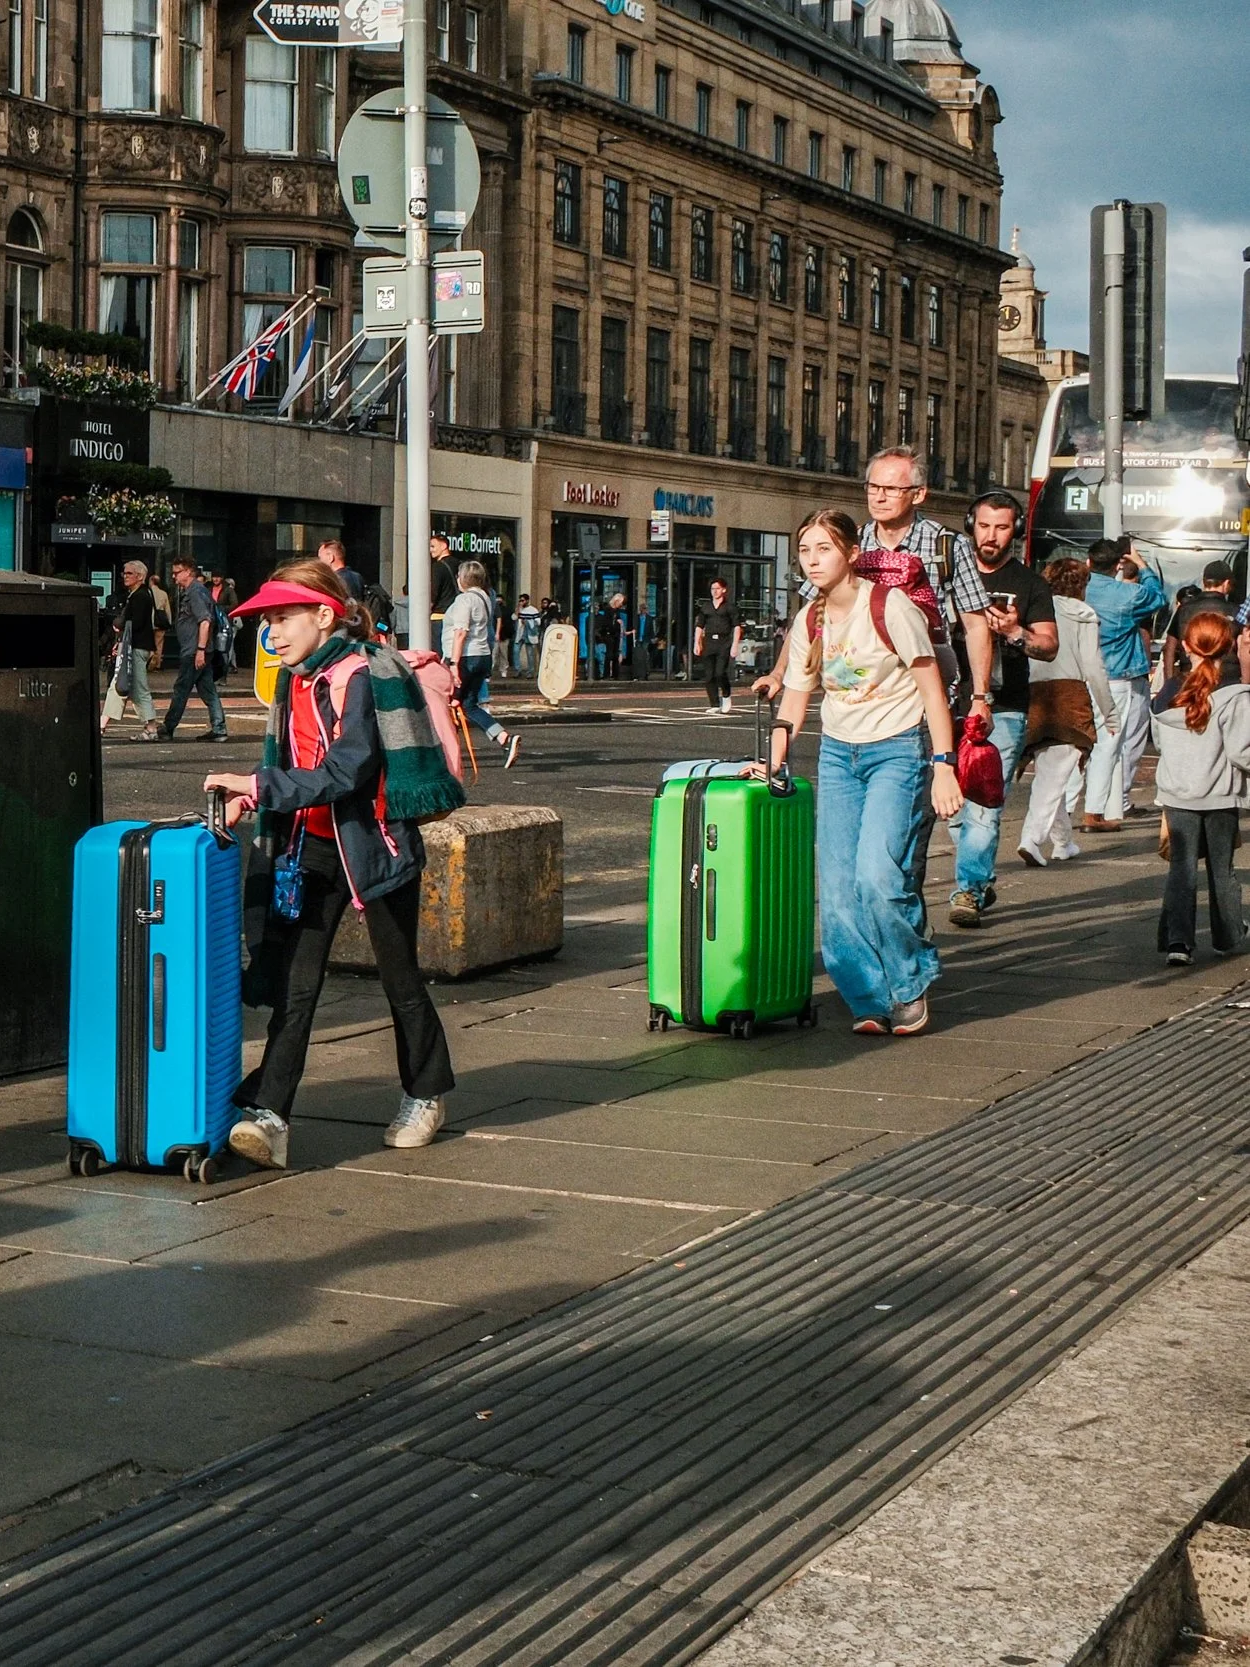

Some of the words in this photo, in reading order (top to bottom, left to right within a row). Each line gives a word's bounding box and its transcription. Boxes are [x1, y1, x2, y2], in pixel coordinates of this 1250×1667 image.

[270, 4, 295, 18] THE
[296, 5, 341, 19] STAND
[270, 17, 310, 25] COMEDY
[316, 18, 341, 26] CLUB
[86, 421, 113, 435] HOTEL
[74, 438, 124, 461] INDIGO
[1083, 458, 1100, 466] BUS
[1146, 459, 1160, 467] OF
[1161, 459, 1177, 467] THE
[1179, 459, 1202, 467] YEAR
[563, 481, 586, 504] Foot
[665, 491, 714, 518] BARCLAYS
[470, 533, 501, 554] Barrett
[18, 677, 53, 698] Litter
